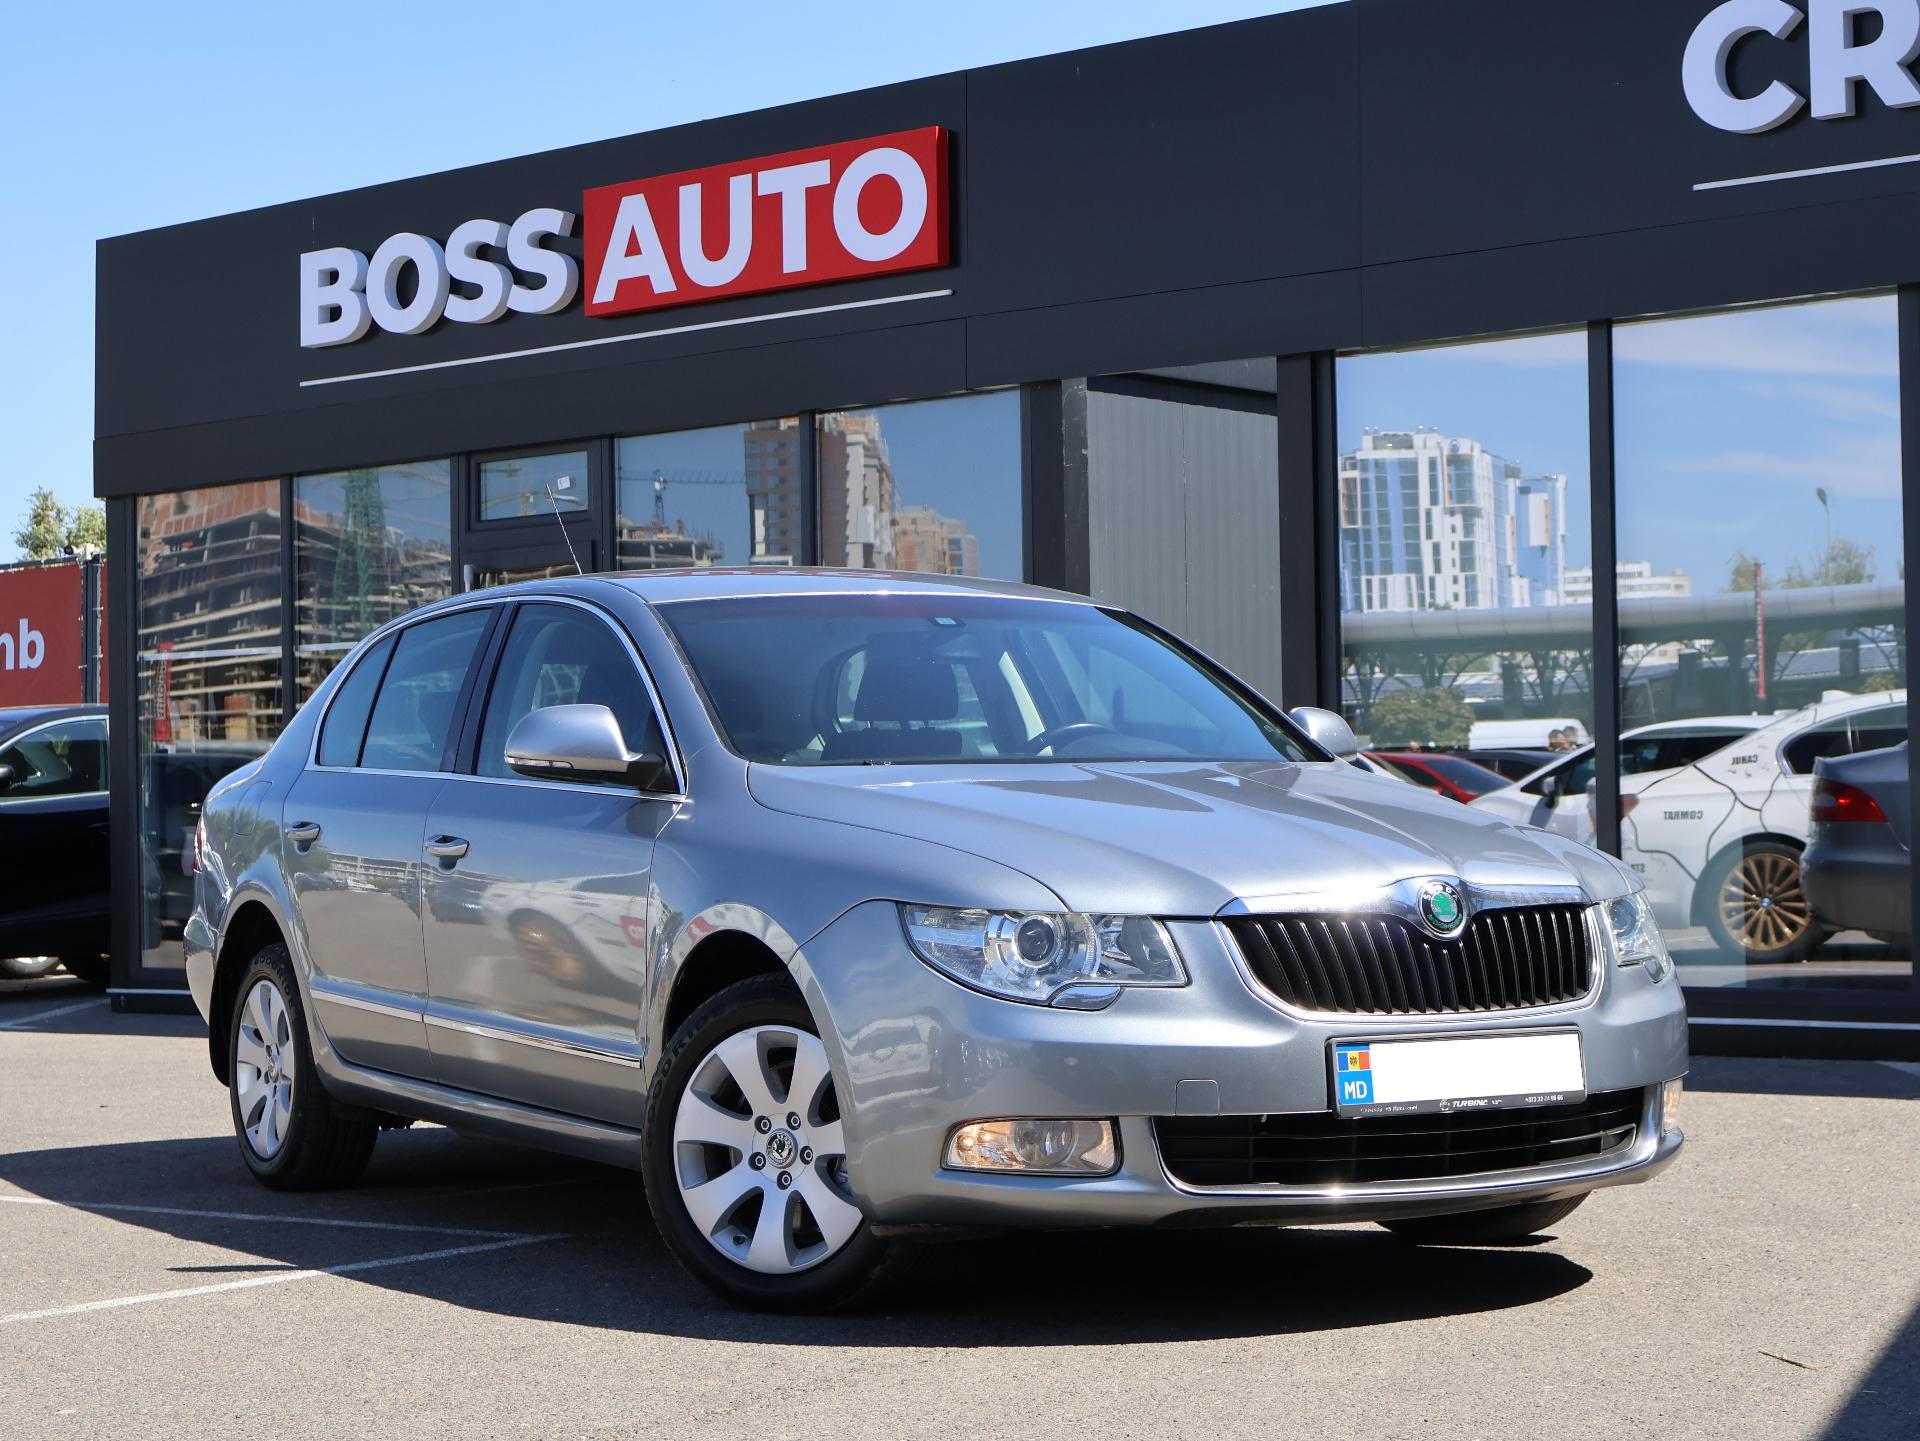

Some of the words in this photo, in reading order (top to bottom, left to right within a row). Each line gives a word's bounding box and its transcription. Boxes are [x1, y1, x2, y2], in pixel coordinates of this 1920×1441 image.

[299, 207, 579, 349] BOSS
[591, 146, 929, 305] AUTO
[1343, 1079, 1369, 1100] MD
